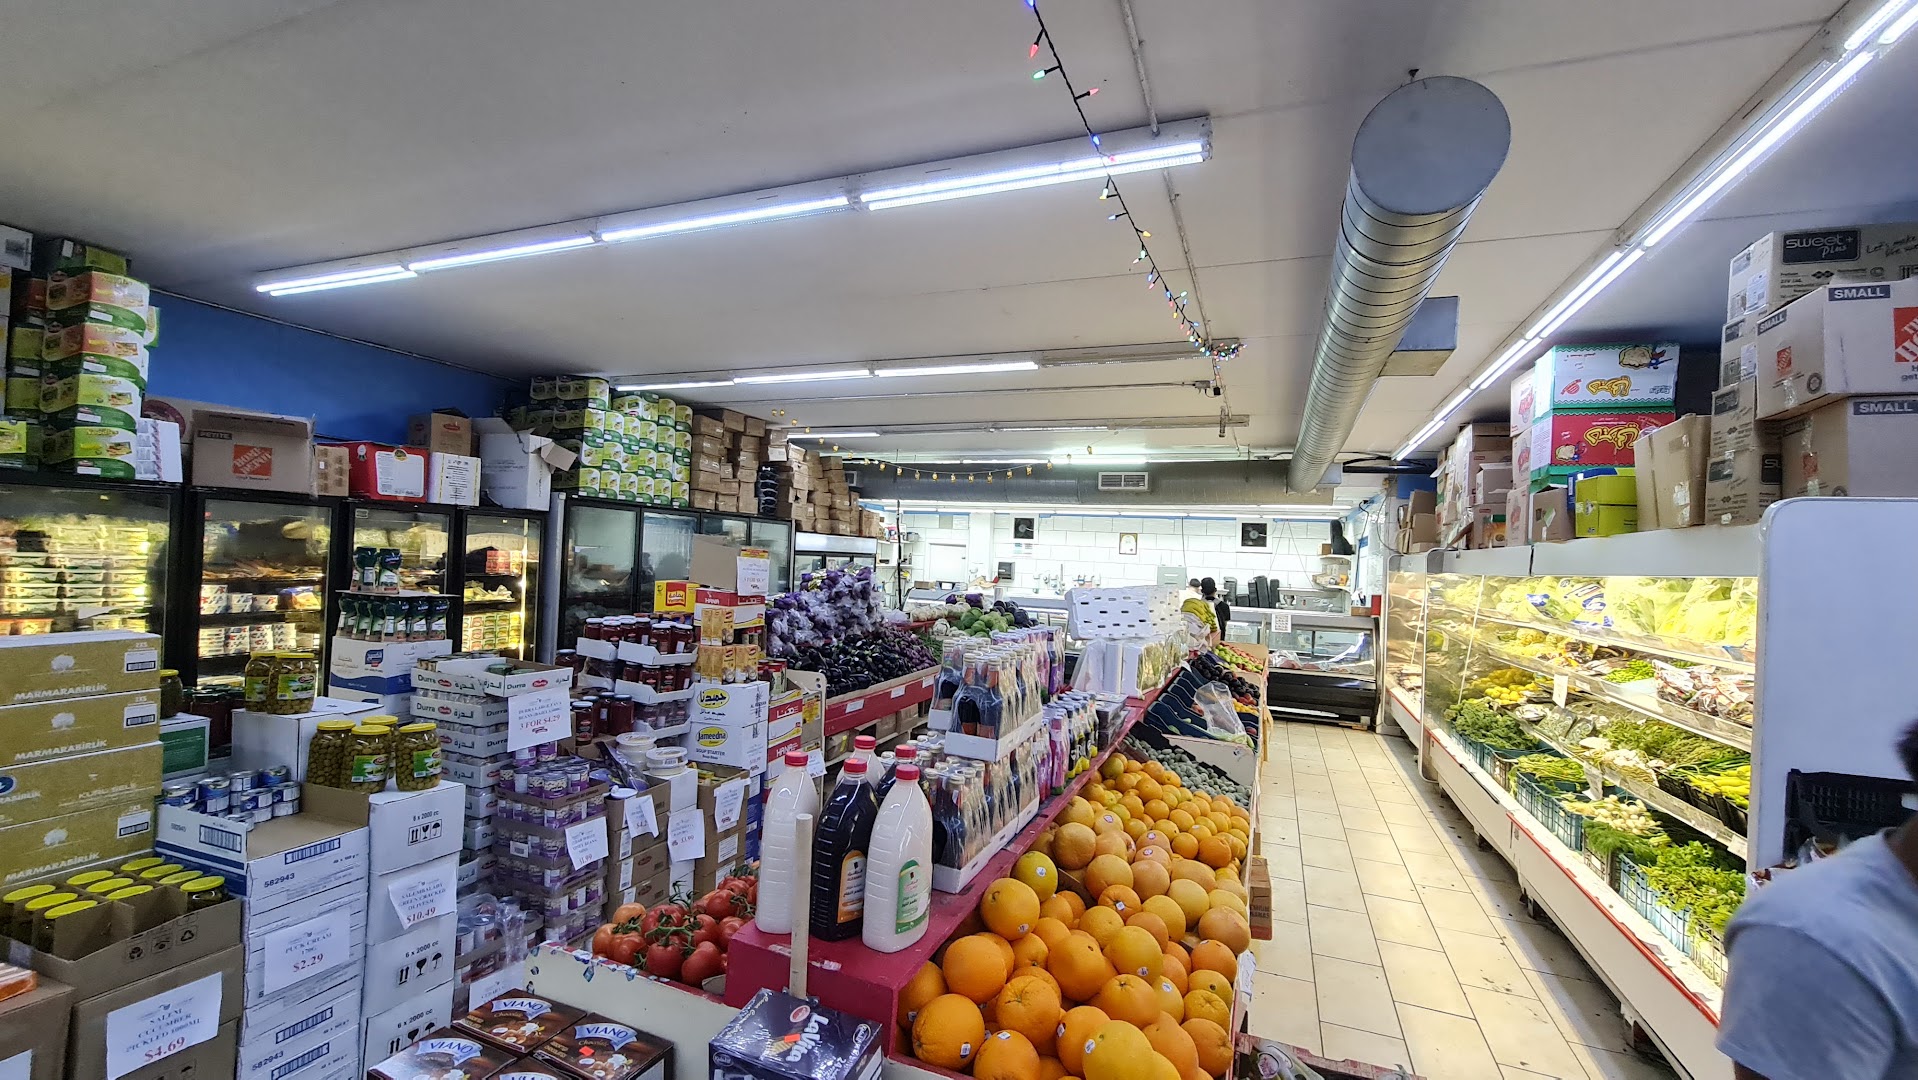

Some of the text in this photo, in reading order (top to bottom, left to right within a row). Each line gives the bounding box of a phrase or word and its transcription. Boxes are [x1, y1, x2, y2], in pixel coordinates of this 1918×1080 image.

[1785, 234, 1844, 249] sweet
[1818, 244, 1847, 258] plus
[1834, 287, 1885, 299] SMALL
[1759, 311, 1786, 333] SMALL
[1859, 402, 1914, 413] SMALL
[417, 674, 437, 684] Durra
[416, 702, 436, 712] Durra
[486, 708, 508, 716] Durra
[525, 720, 542, 728] FOR
[698, 731, 726, 742] Jameedna
[486, 738, 508, 748] Durra
[264, 872, 296, 888] 582943
[406, 906, 436, 924] $10.49
[416, 943, 431, 954] 2000
[292, 952, 324, 973] $2.29
[502, 999, 544, 1010] VIANO
[409, 1012, 424, 1024] 2000
[586, 1026, 630, 1038] VIANO
[144, 1036, 186, 1062] $4.69
[430, 1040, 474, 1054] VIANO
[252, 1050, 284, 1071] 582943
